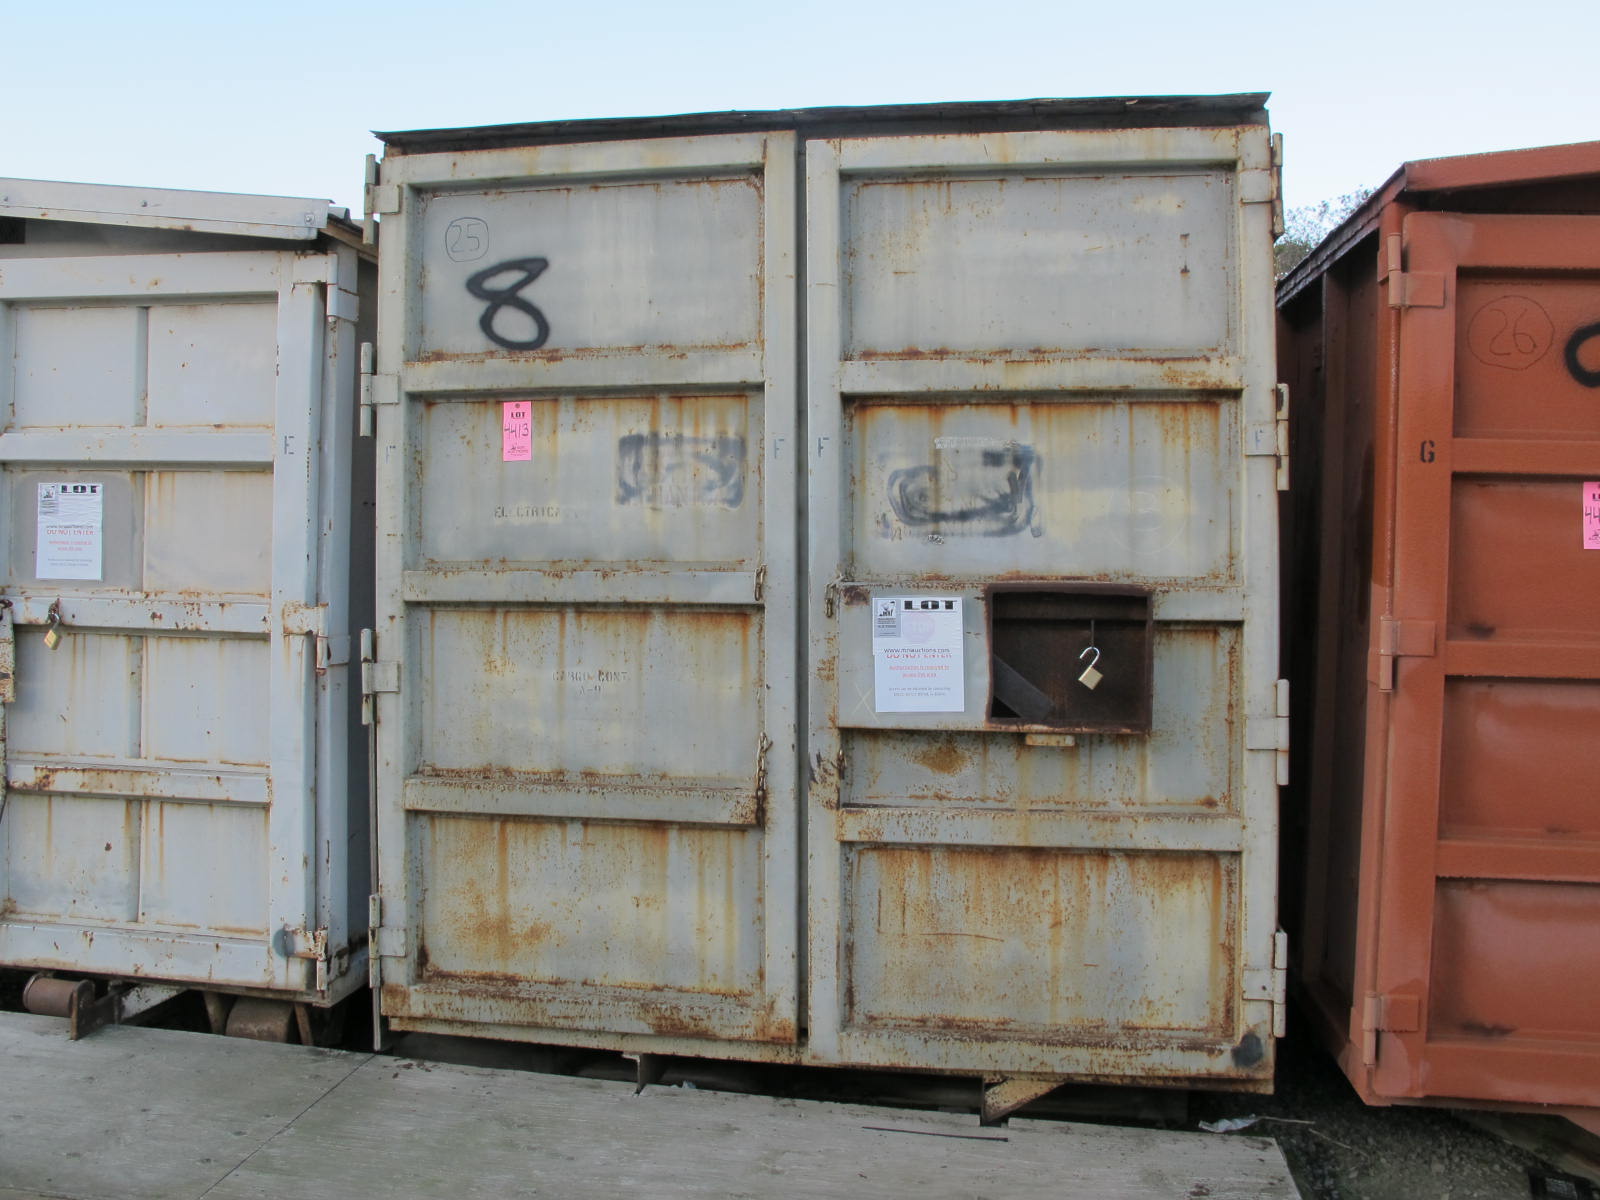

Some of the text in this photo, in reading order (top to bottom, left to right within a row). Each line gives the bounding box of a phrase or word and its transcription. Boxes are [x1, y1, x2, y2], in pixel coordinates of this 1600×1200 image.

[450, 222, 481, 253] 25
[465, 257, 550, 350] 8
[1489, 308, 1538, 356] 26
[511, 411, 526, 419] LOT
[504, 423, 529, 439] 4413
[817, 437, 830, 458] F
[1419, 440, 1436, 463] G
[904, 600, 957, 610] LOT
